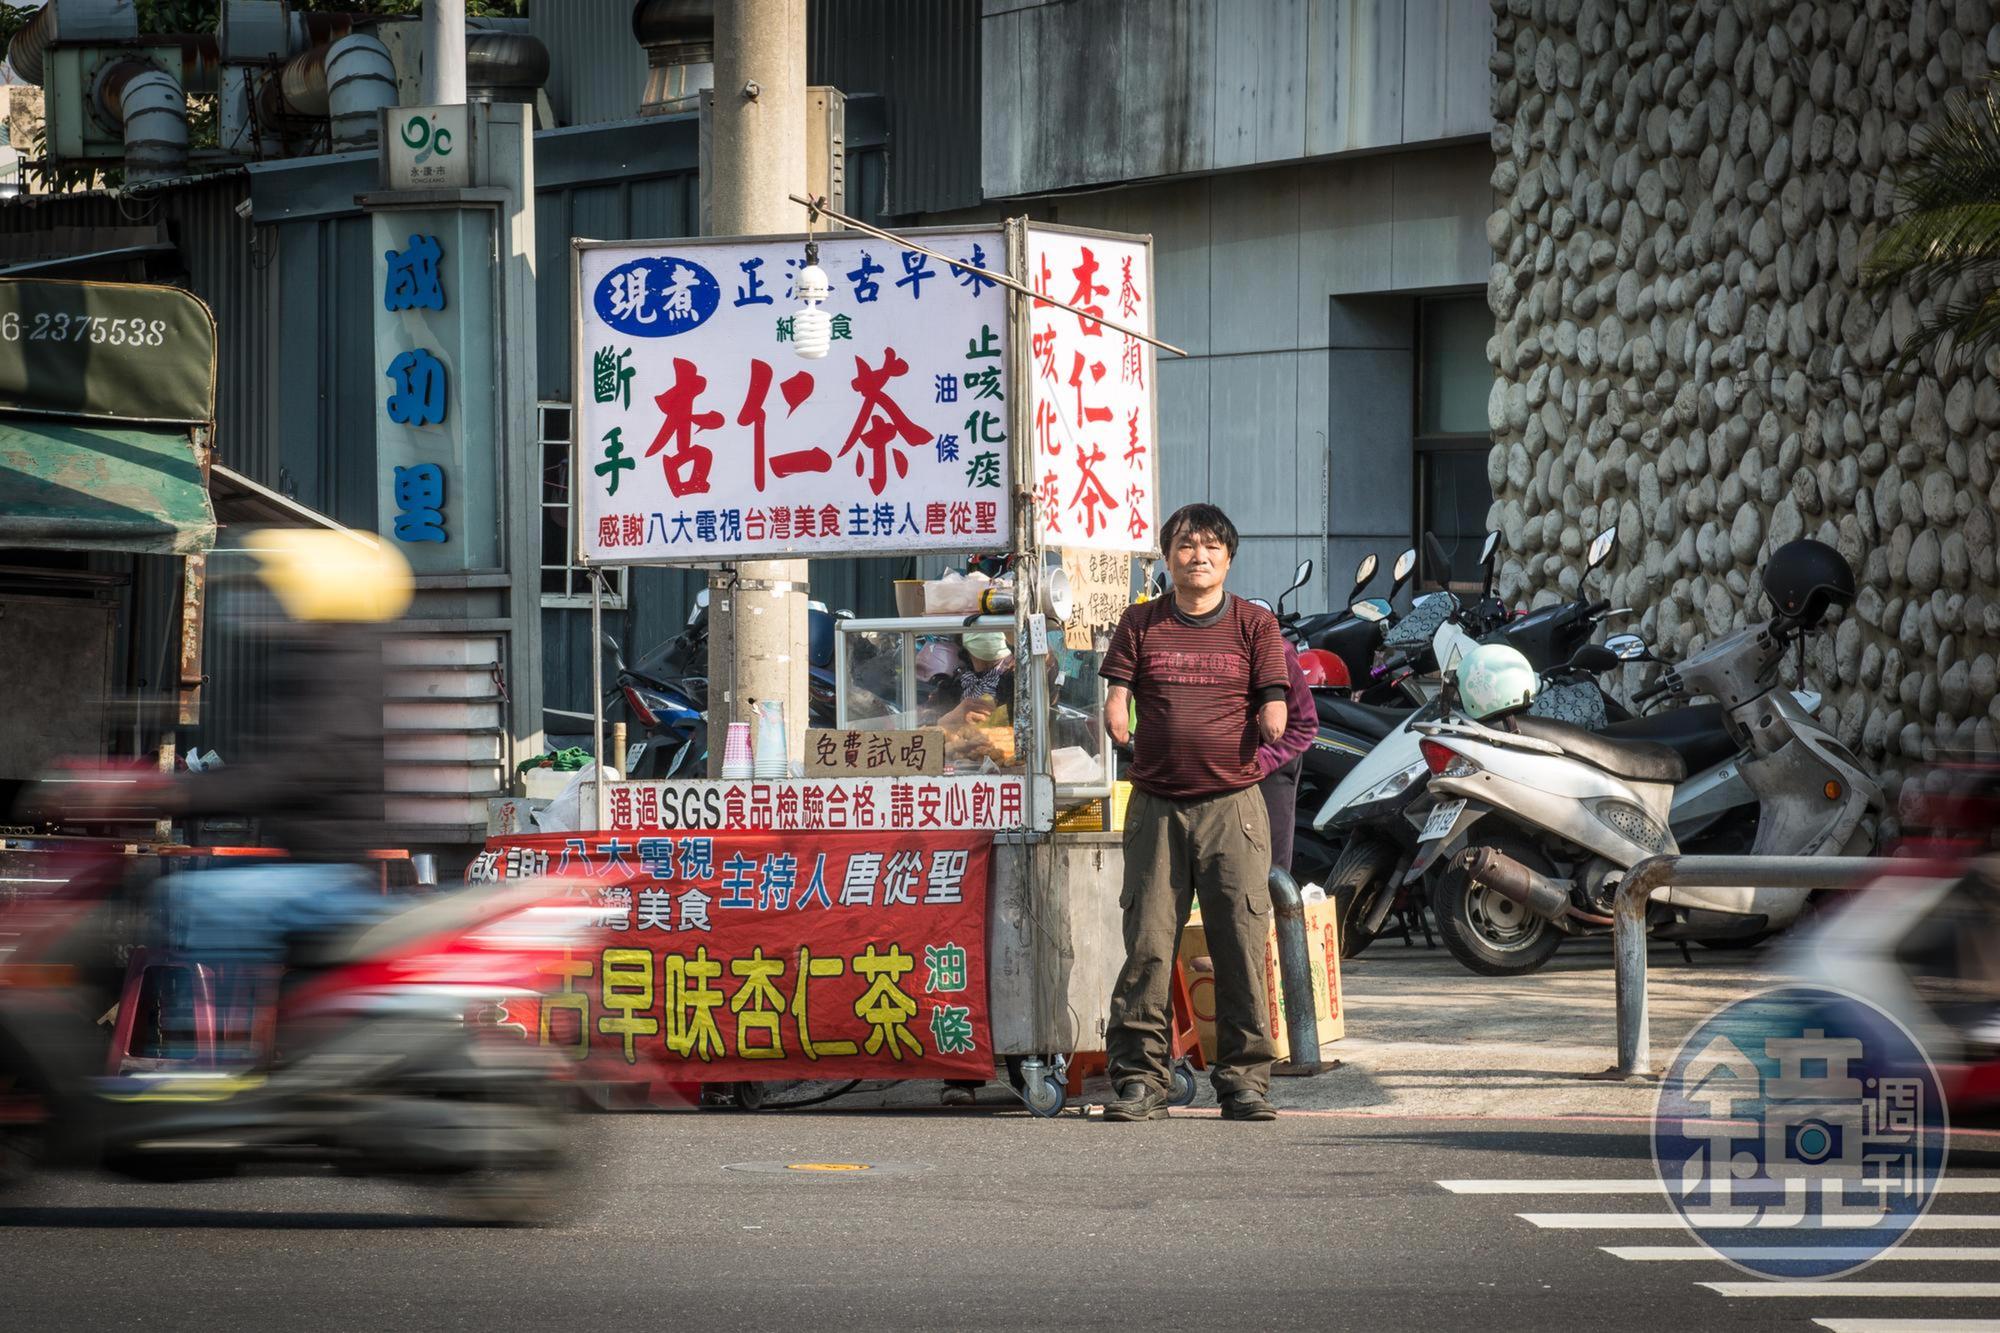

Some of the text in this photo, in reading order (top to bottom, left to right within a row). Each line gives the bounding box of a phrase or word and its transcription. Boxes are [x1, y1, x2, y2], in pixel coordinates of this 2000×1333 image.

[608, 267, 702, 324] 現煮
[776, 313, 853, 343] 純食
[385, 234, 447, 543] 成功里
[594, 346, 636, 497] 斷手
[645, 346, 935, 498] 杏仁茶
[934, 373, 960, 464] 油條
[963, 324, 1007, 489] 止咳化痰
[1032, 251, 1062, 534] 止咳化痰
[1067, 246, 1119, 538] 杏仁茶
[816, 732, 927, 771] 免費試喝
[924, 942, 976, 1056] 油條
